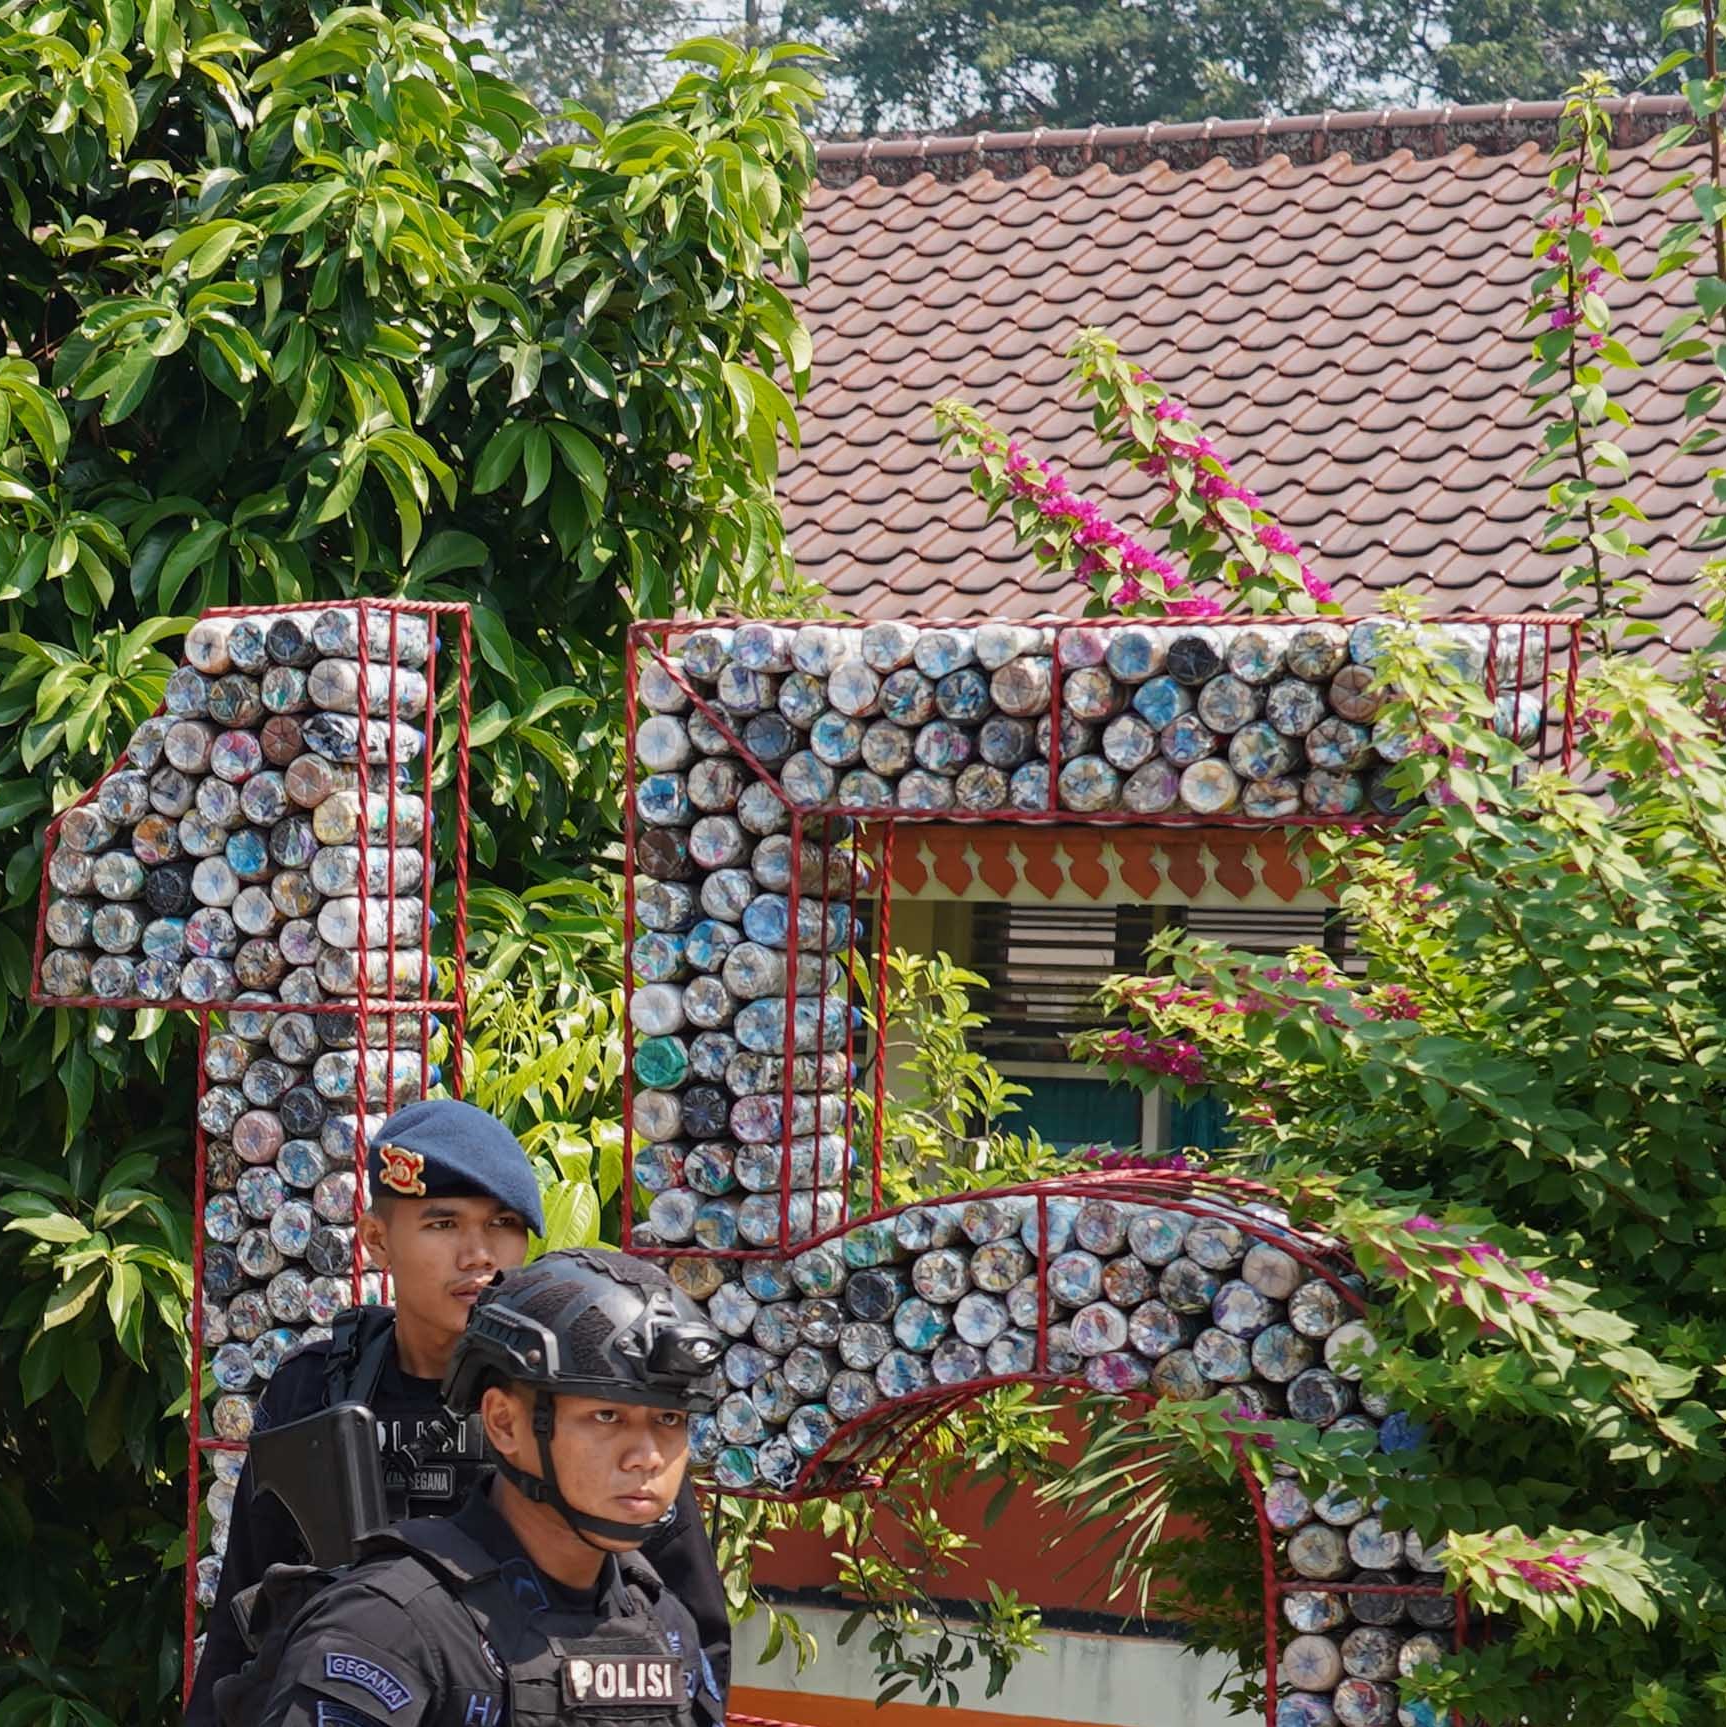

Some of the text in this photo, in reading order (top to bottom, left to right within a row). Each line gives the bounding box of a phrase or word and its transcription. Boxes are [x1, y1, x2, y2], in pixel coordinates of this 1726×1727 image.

[409, 1471, 449, 1492] EGANA
[332, 1658, 403, 1703] GEGANA
[570, 1659, 674, 1699] POLISI
